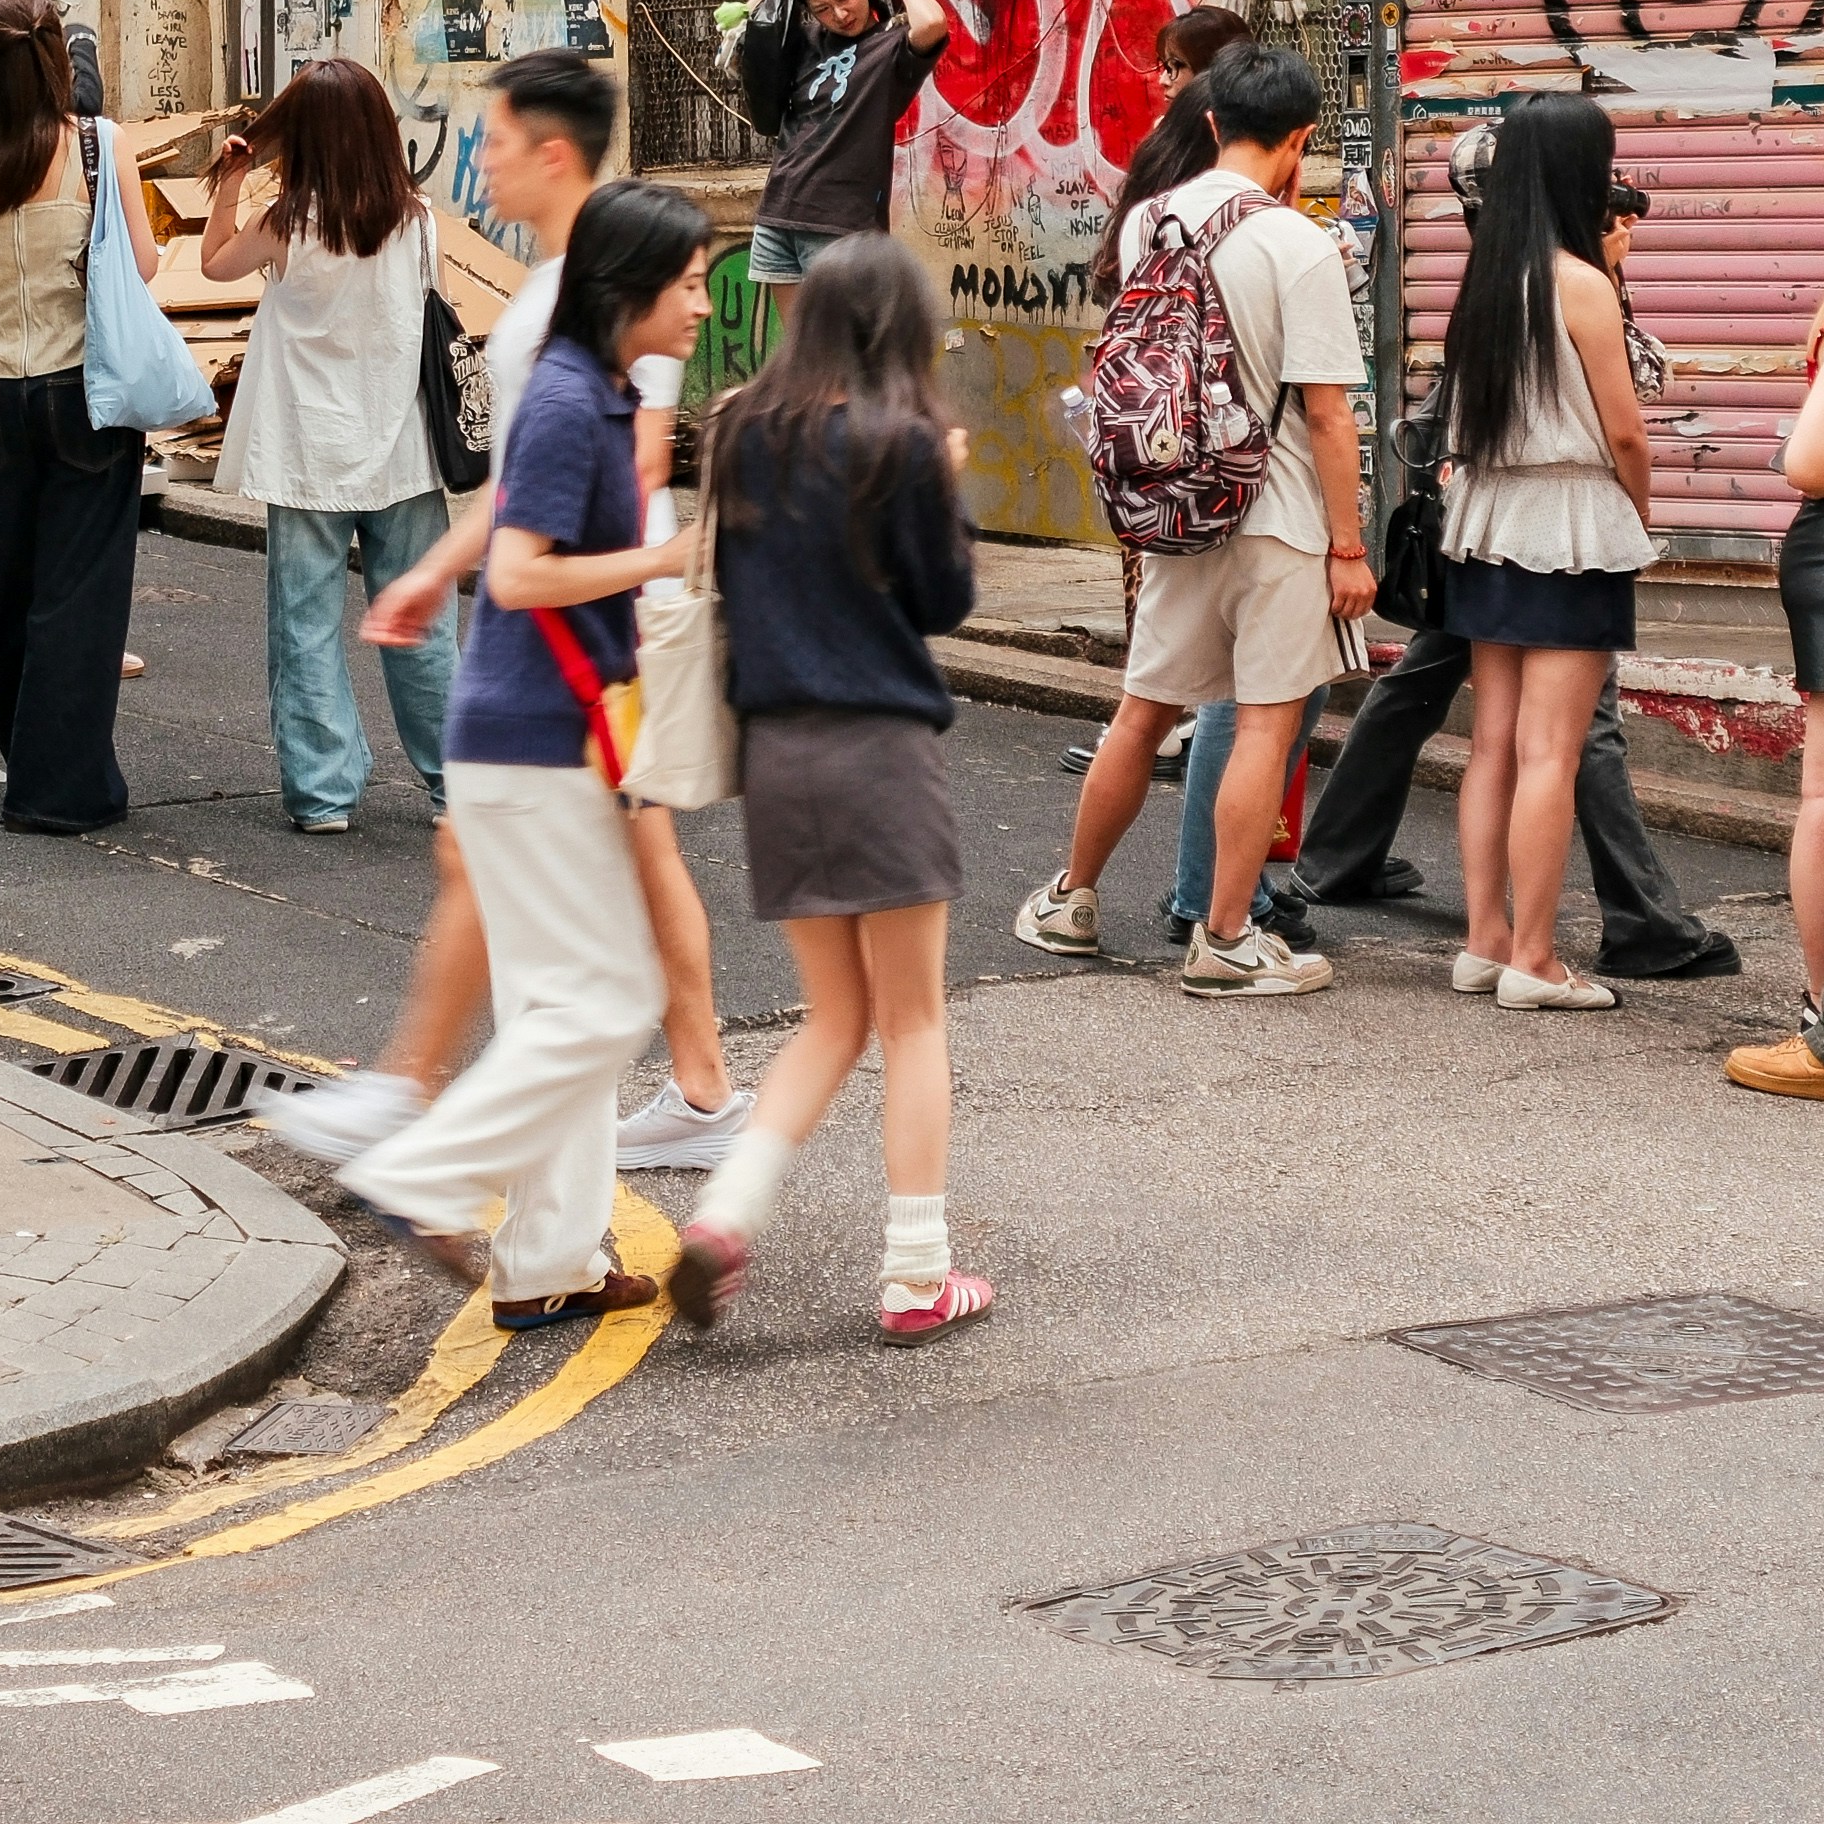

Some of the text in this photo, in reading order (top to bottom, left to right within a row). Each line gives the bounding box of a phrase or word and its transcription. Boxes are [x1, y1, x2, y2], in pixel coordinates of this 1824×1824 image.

[150, 85, 181, 98] LESS
[154, 98, 185, 115] SAD
[1056, 179, 1095, 195] SLAVE
[1070, 200, 1090, 218] OF
[1069, 214, 1105, 237] NONE
